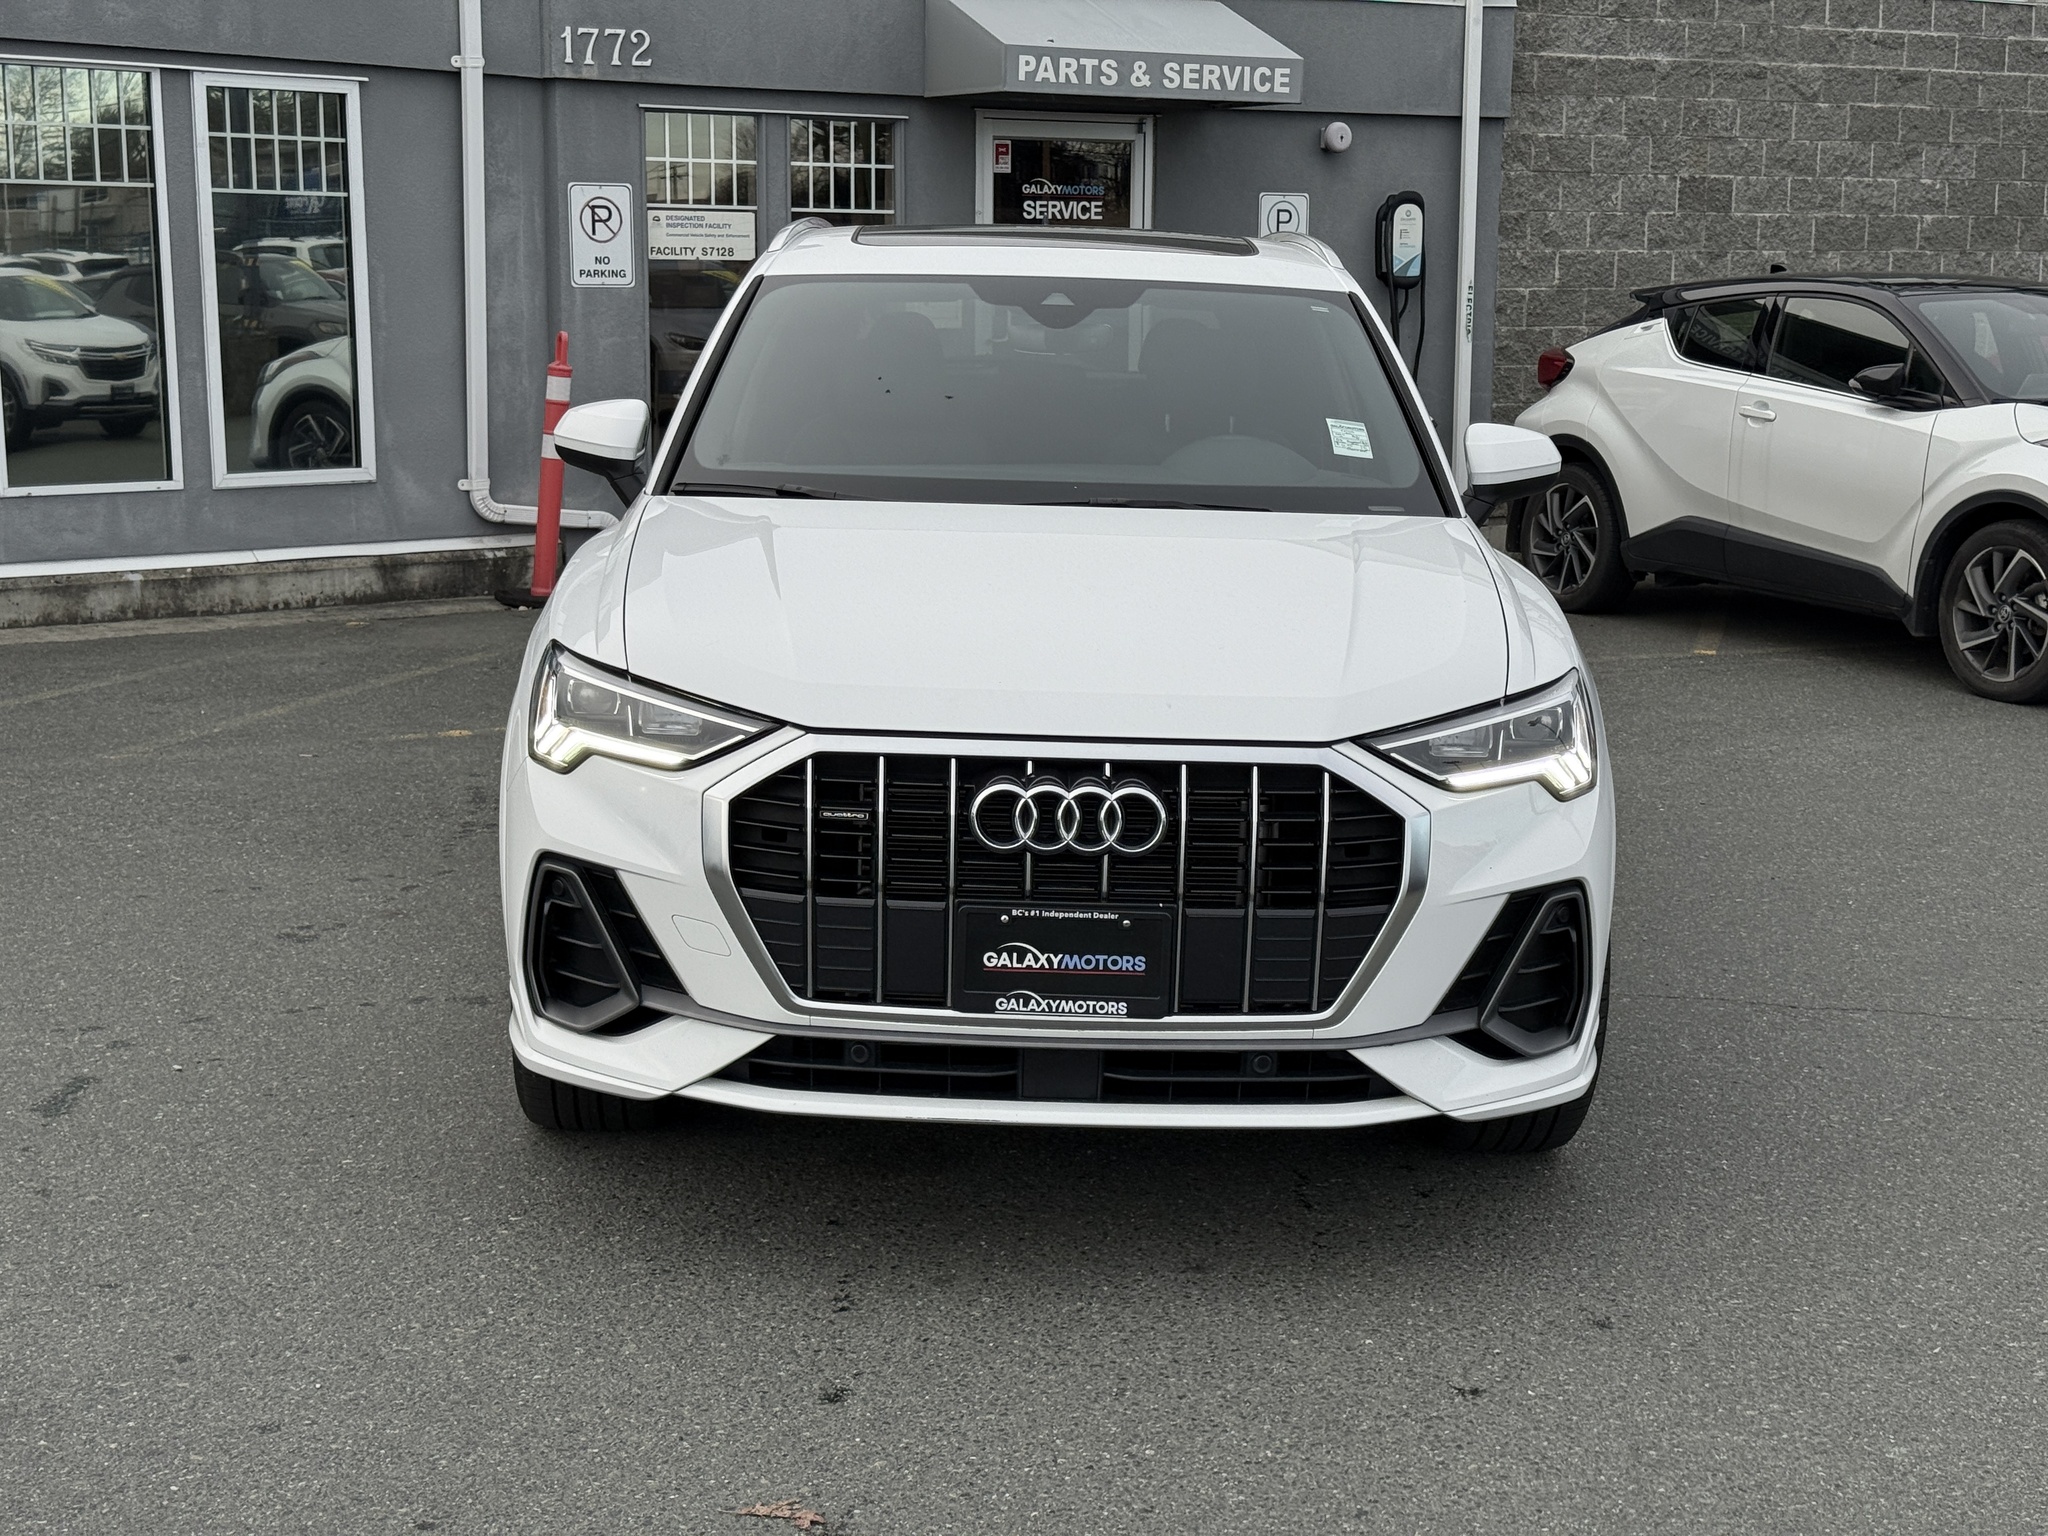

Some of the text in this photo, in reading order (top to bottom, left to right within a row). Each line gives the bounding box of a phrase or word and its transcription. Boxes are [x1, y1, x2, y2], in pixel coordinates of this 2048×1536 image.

[560, 26, 653, 67] 1772
[1018, 54, 1291, 94] PARTS & SERVICE
[1022, 200, 1103, 220] SERVICE
[650, 246, 735, 257] FACILITY S7128
[594, 256, 611, 265] NO
[579, 269, 627, 279] PARKING
[1011, 909, 1120, 920] BC's #1 Independent Dealer
